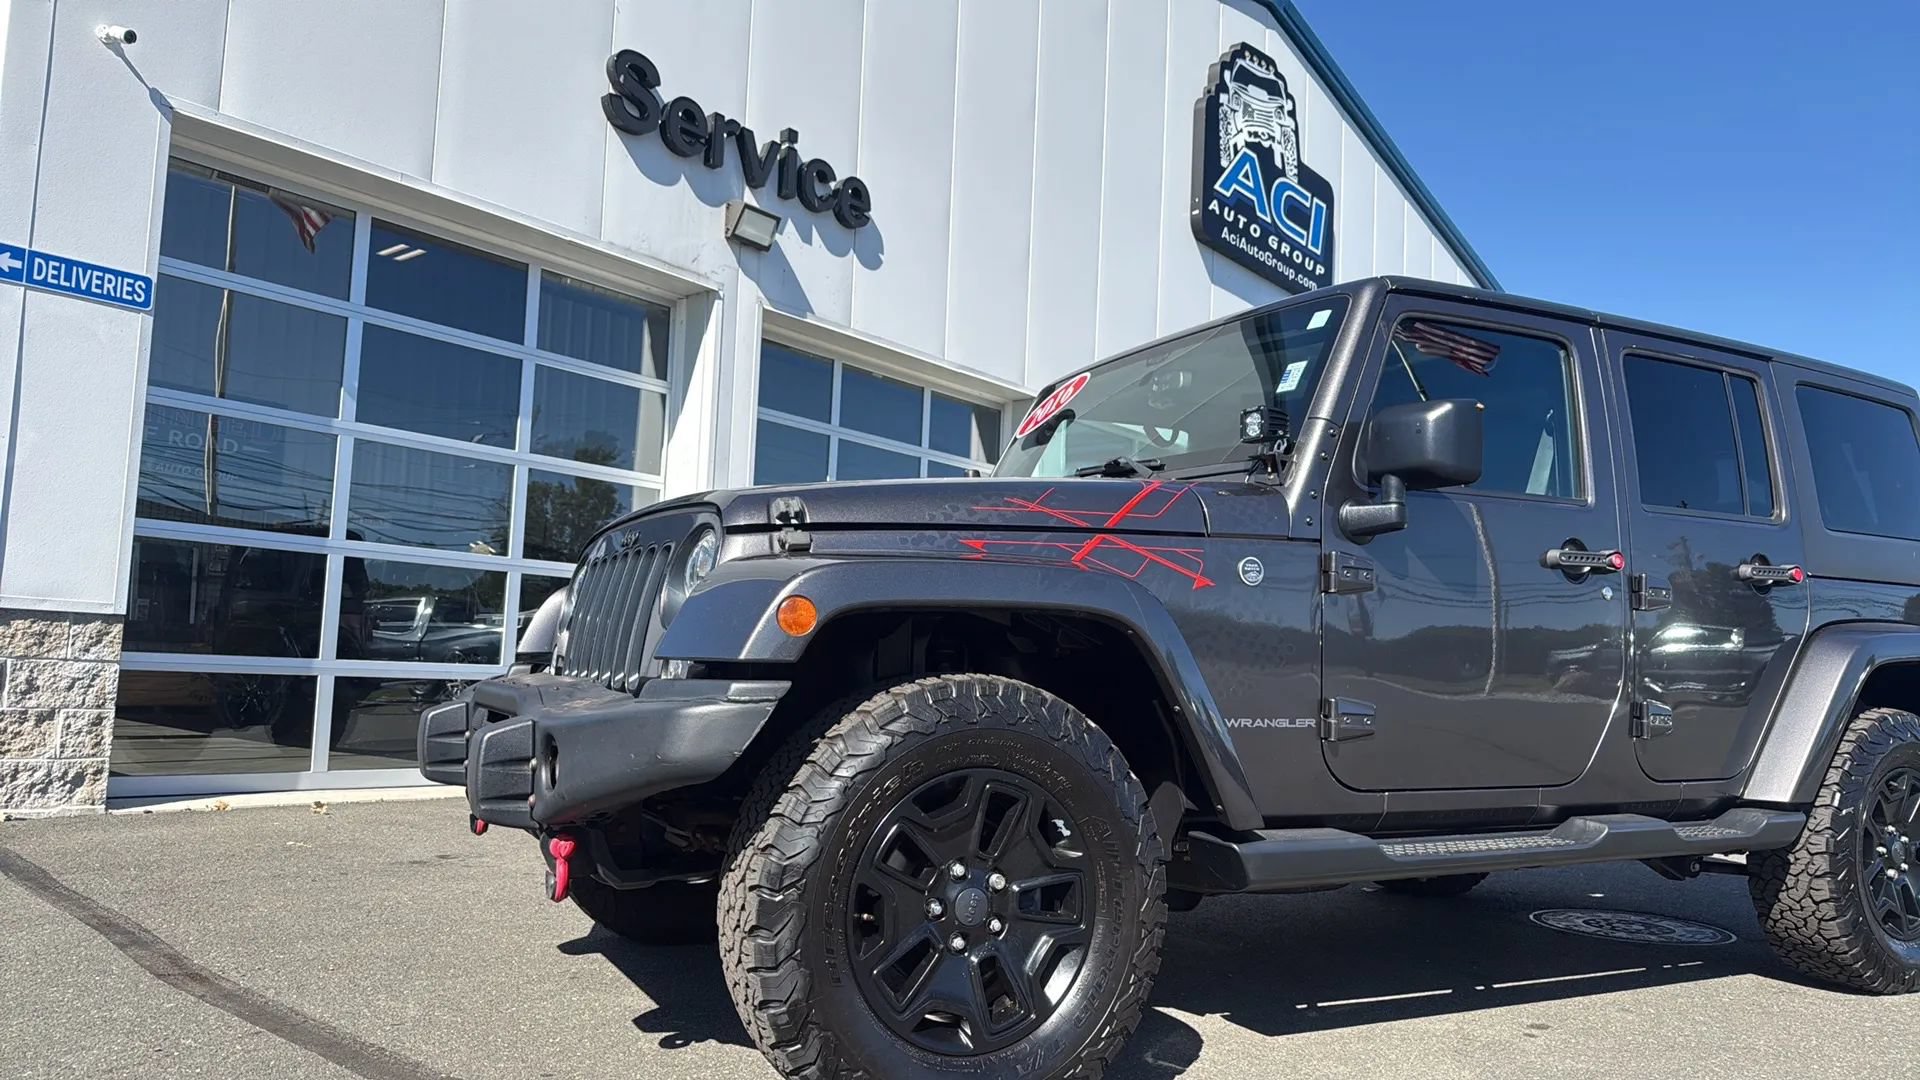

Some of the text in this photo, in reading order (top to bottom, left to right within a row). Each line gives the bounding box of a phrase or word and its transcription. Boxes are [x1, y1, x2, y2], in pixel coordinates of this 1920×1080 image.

[601, 49, 871, 229] Service
[1213, 147, 1327, 256] ACI
[1208, 199, 1326, 276] AUTO GROUP
[1221, 226, 1318, 291] AciAutoGroup.com
[32, 257, 146, 303] DELIVERIES
[1224, 718, 1317, 728] WRANGLER
